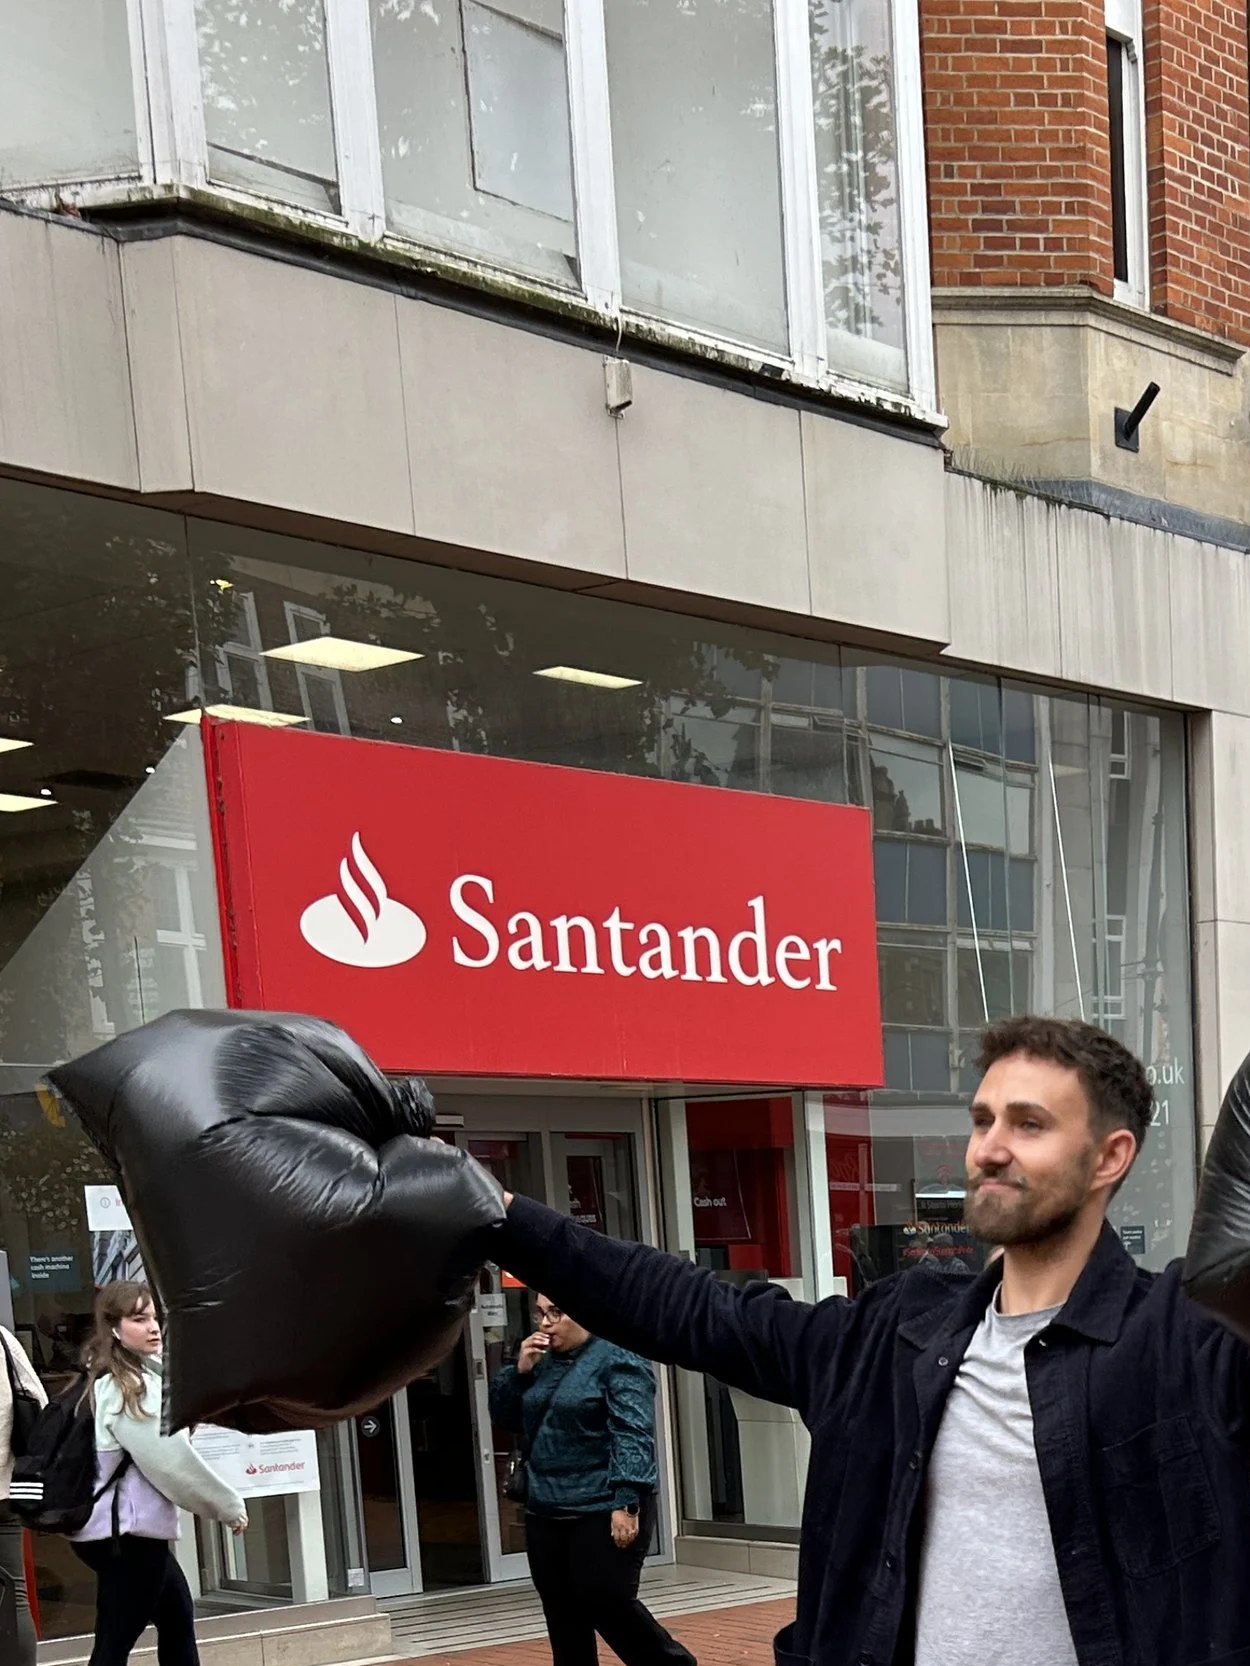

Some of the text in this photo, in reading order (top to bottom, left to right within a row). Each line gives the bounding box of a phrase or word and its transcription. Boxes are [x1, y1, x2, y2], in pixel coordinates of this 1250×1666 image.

[450, 873, 842, 992] Santander
[694, 1196, 728, 1207] Cash out
[258, 1461, 305, 1474] Santander
